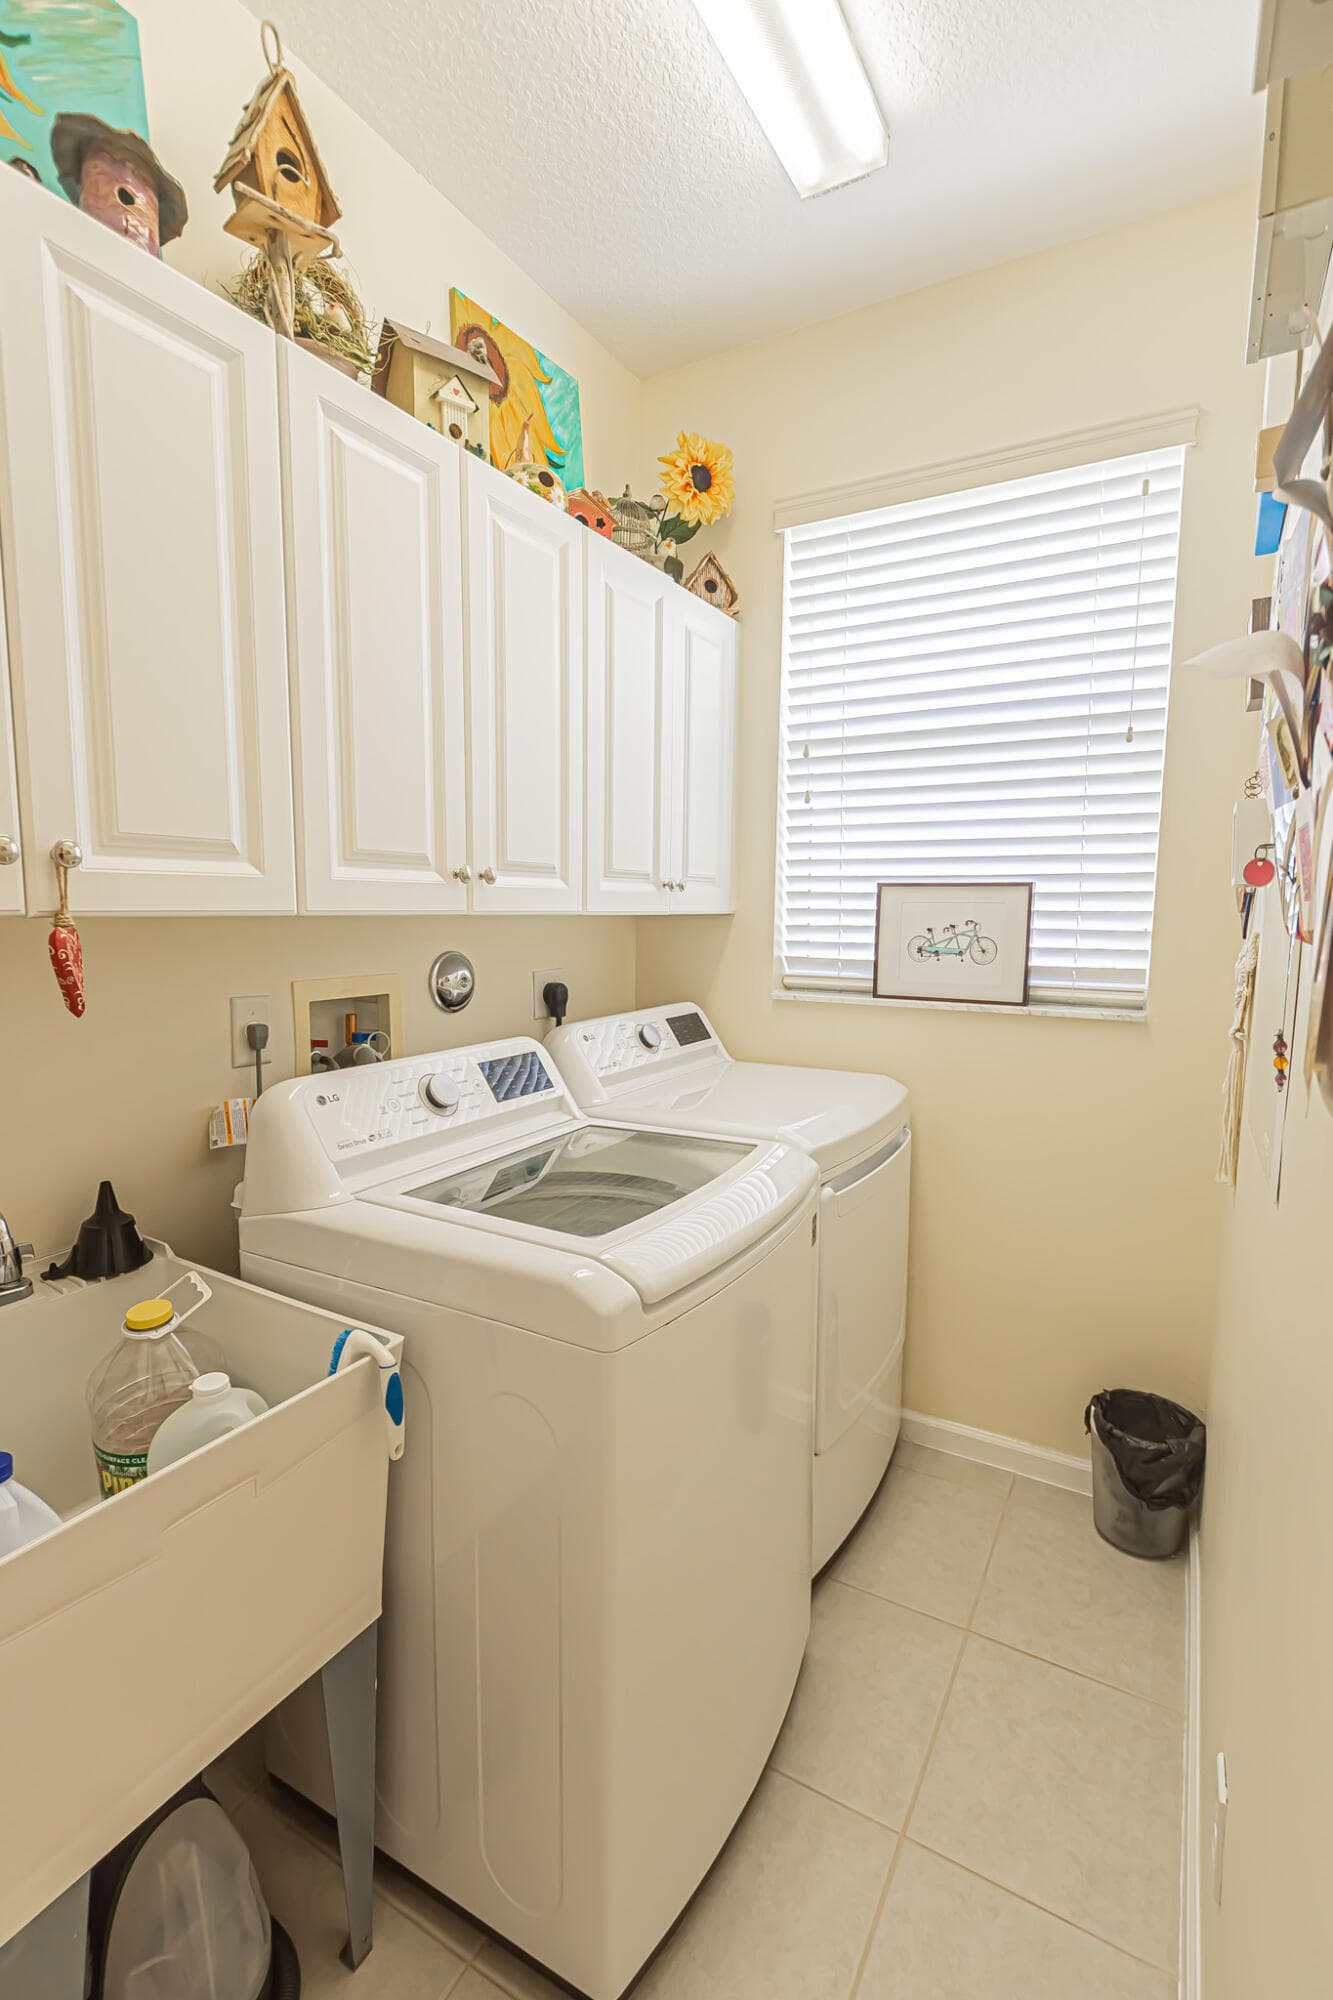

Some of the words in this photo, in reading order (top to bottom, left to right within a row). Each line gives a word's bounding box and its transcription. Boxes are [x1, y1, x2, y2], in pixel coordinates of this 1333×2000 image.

[327, 1093, 340, 1103] LG
[337, 1142, 353, 1151] Direct
[102, 1471, 143, 1494] Pin
